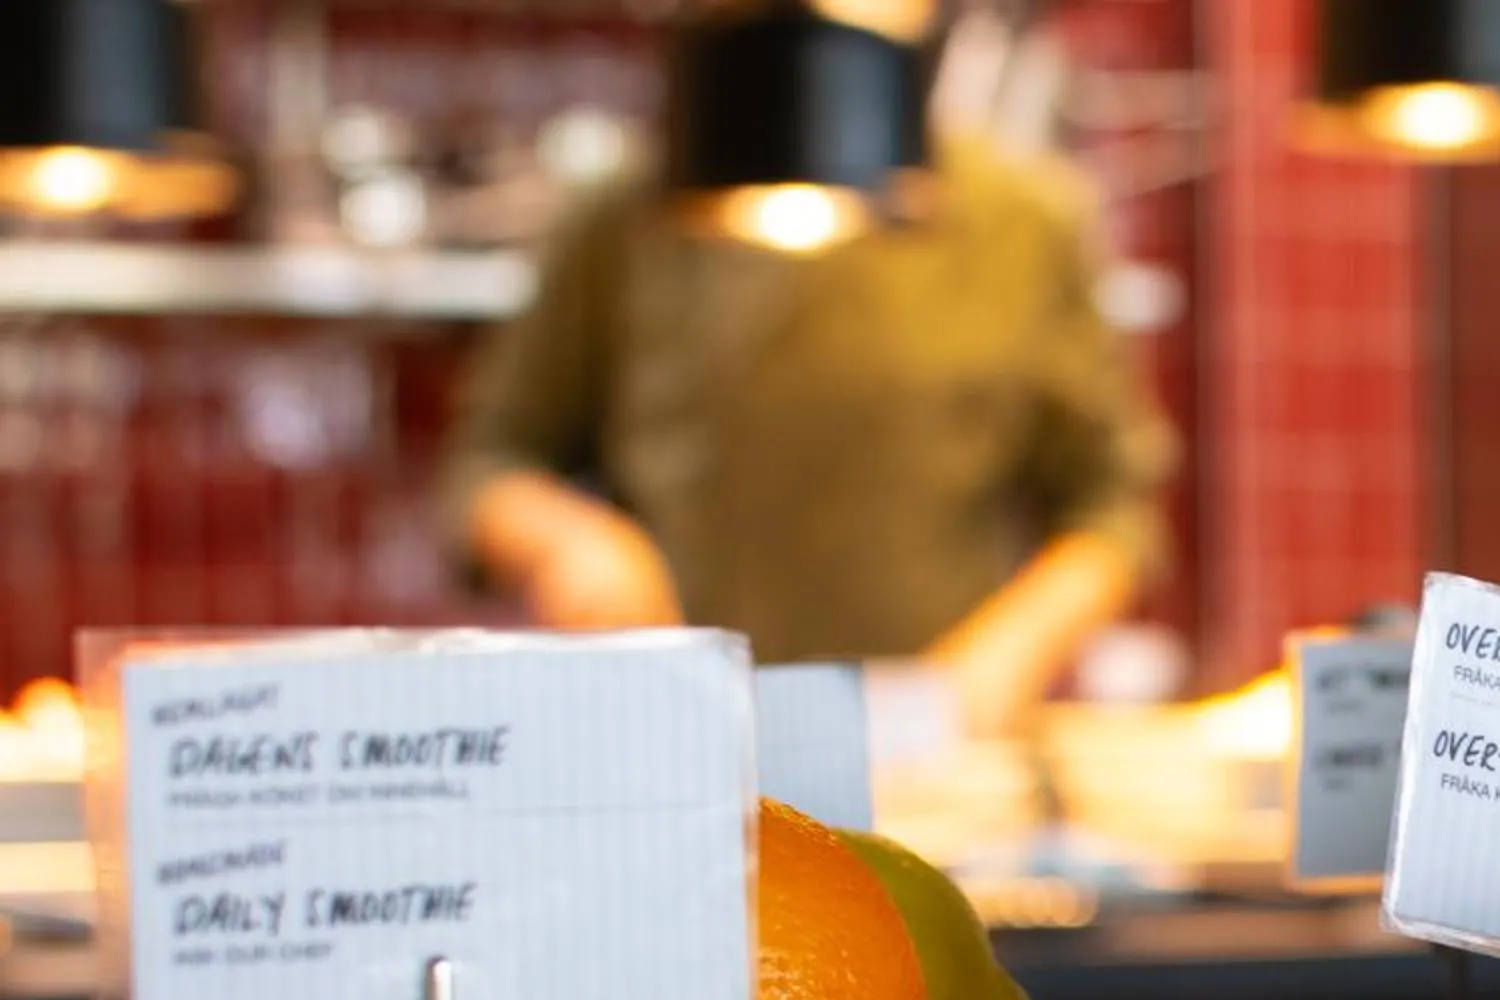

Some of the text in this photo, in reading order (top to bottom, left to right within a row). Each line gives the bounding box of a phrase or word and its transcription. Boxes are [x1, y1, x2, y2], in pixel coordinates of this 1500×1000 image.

[171, 726, 509, 777] DAGENS SMOOTHIE
[176, 883, 475, 935] DAILY SMOOTHIE
